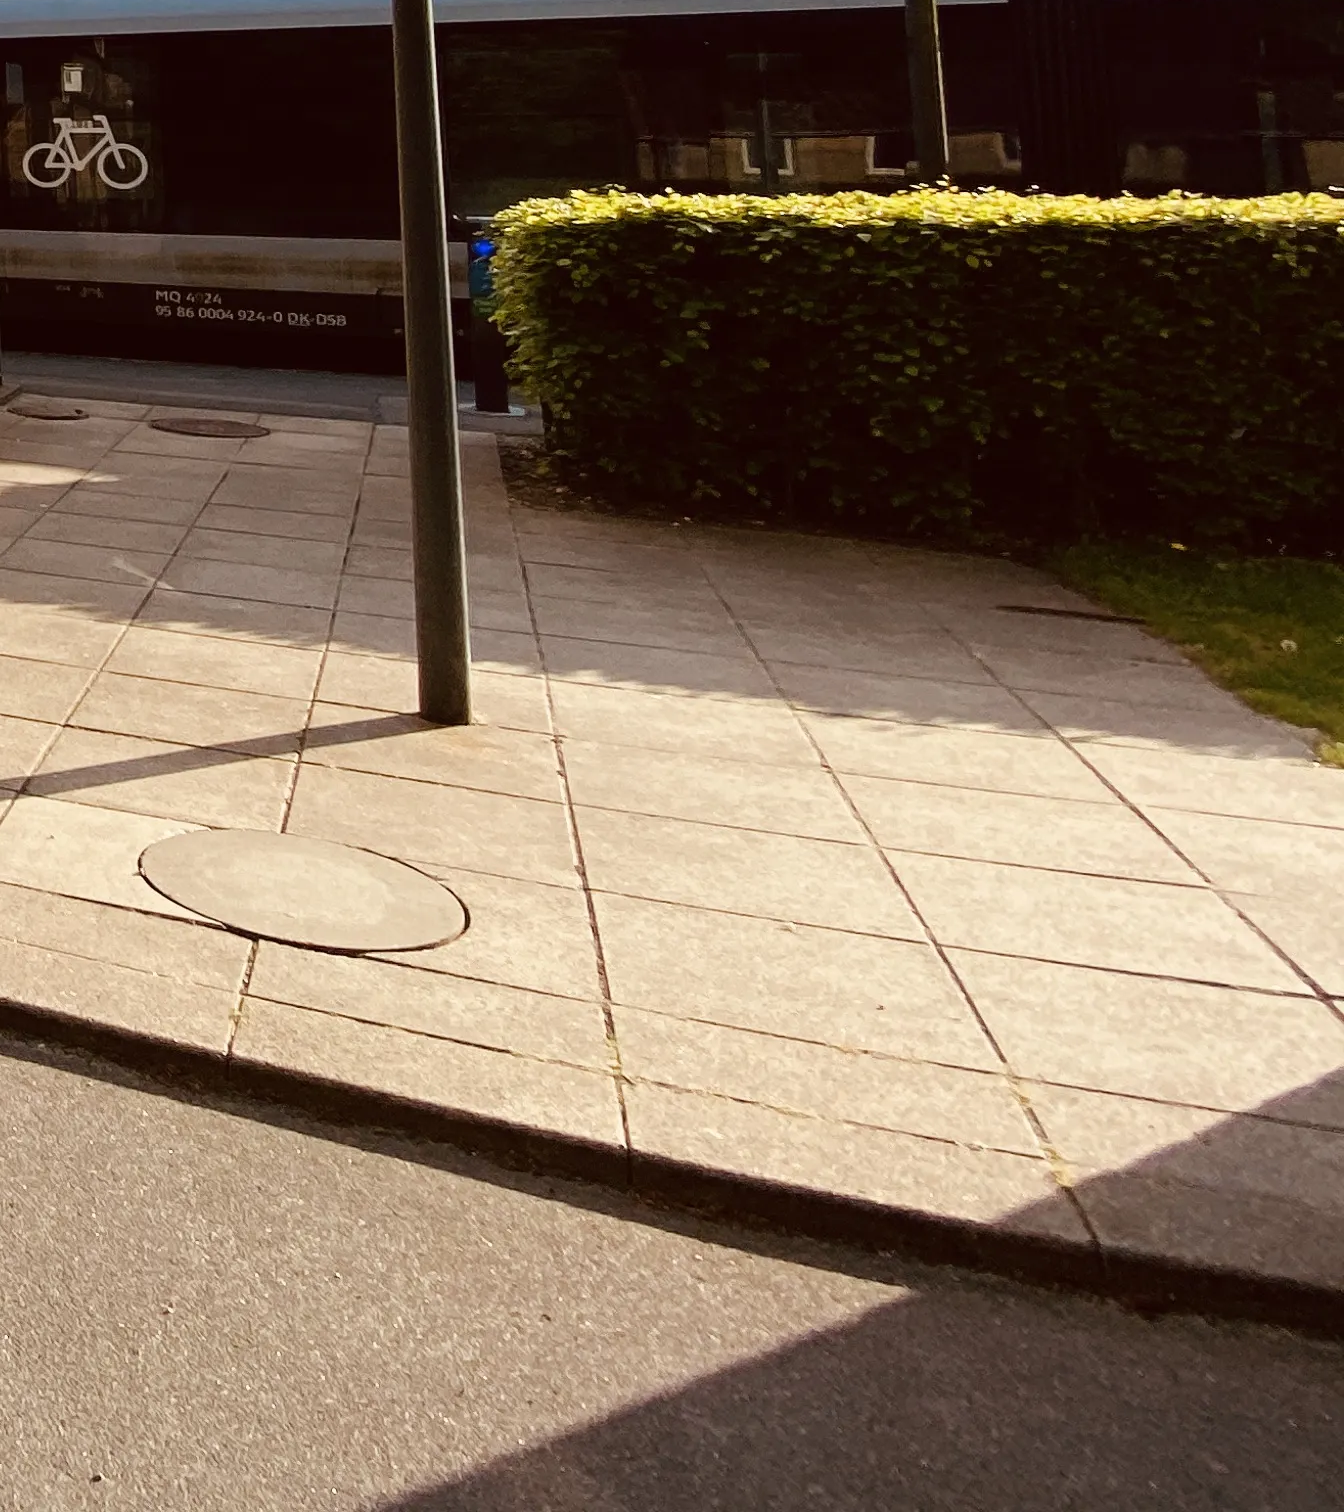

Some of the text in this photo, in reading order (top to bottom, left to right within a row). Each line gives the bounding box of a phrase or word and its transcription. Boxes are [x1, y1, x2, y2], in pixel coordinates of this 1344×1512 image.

[155, 290, 181, 304] MQ
[176, 306, 195, 319] 86
[198, 307, 234, 321] 0004
[237, 309, 283, 323] 924-0
